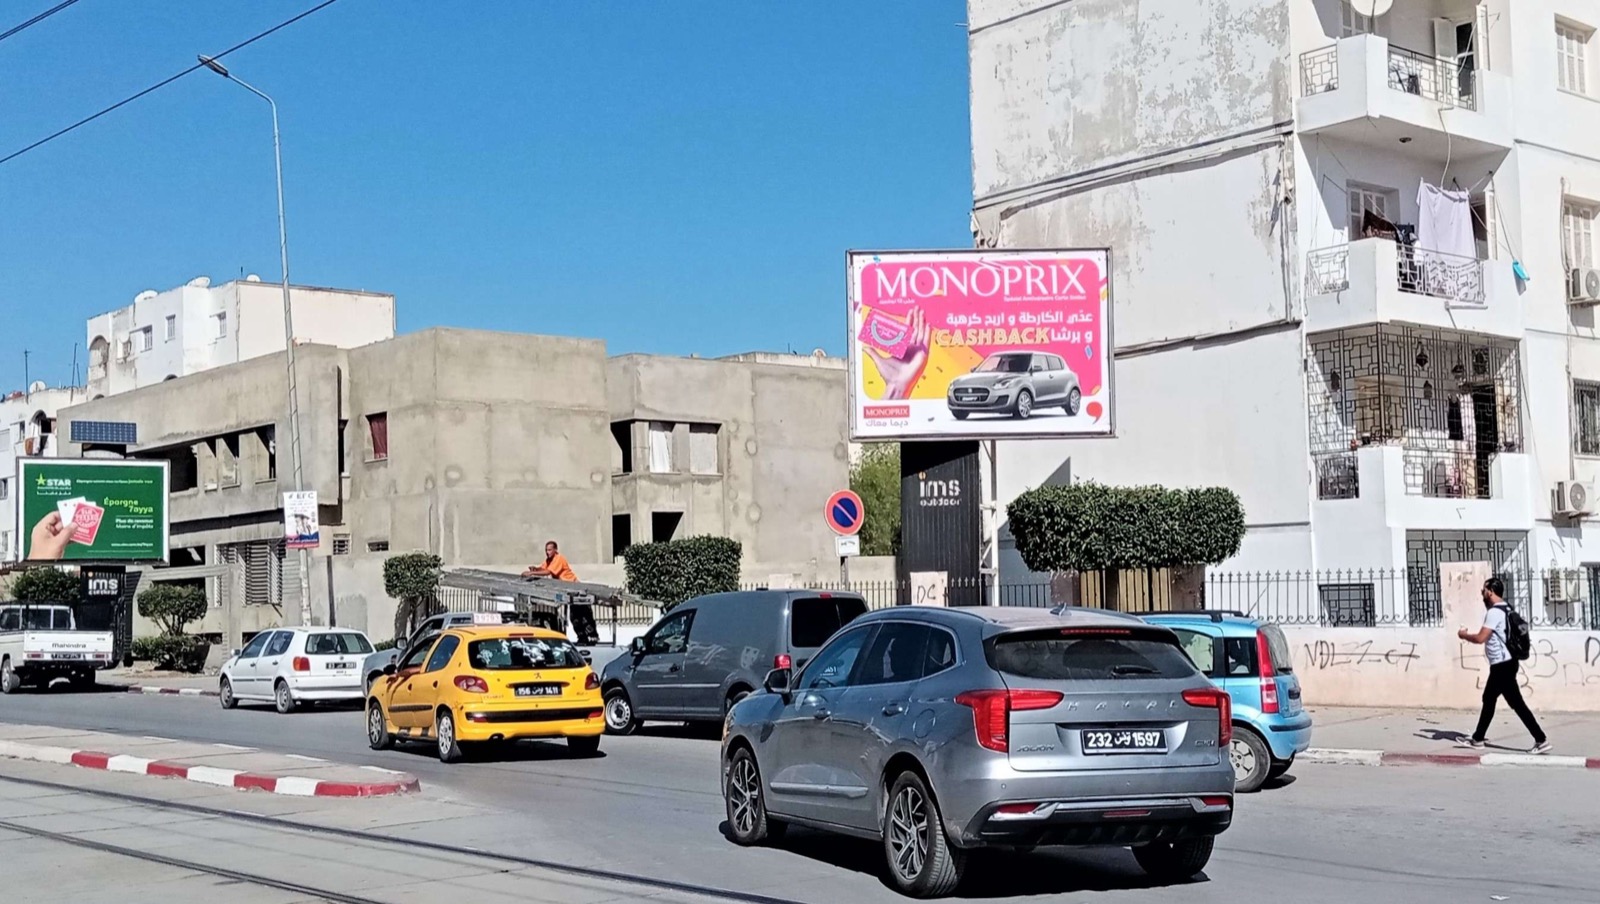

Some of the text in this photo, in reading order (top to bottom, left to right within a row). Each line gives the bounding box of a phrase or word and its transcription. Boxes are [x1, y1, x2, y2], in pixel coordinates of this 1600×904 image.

[876, 263, 1087, 298] MONOPRIX
[1007, 314, 1016, 326] و
[936, 327, 1050, 346] CASHBACK
[1084, 330, 1093, 343] و
[865, 408, 908, 417] MONOPRIX
[47, 479, 71, 487] STAR
[919, 471, 961, 497] ims
[103, 496, 139, 507] Épargne
[919, 497, 962, 506] outdoor
[129, 506, 153, 514] 7ayya
[88, 571, 118, 590] ims
[1087, 732, 1113, 747] 232
[1132, 732, 1161, 746] 1597
